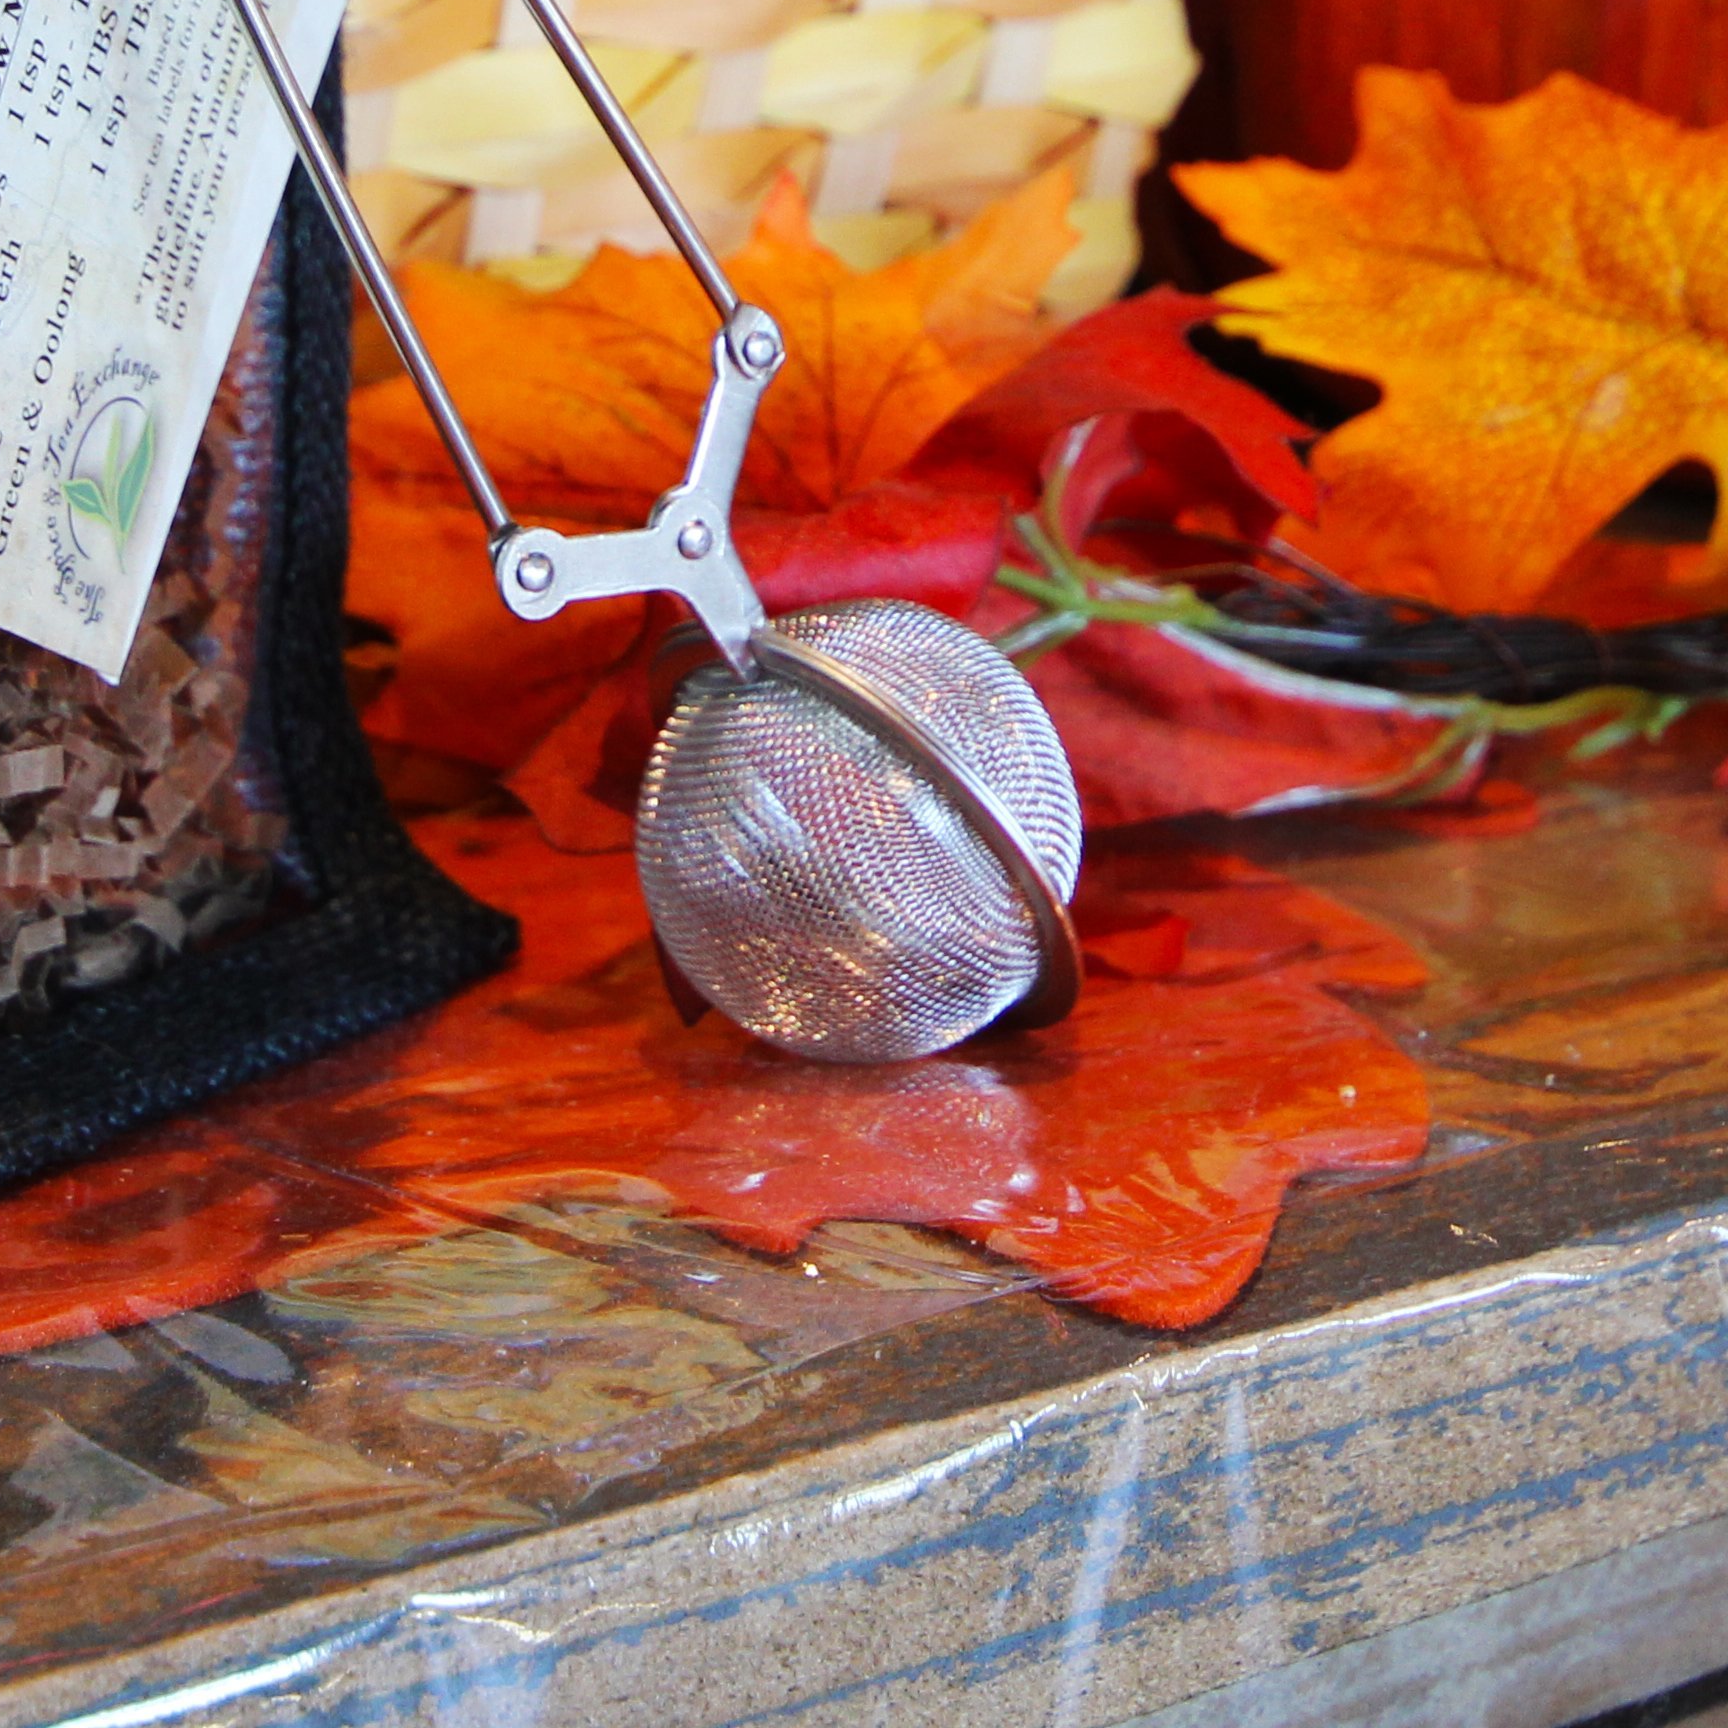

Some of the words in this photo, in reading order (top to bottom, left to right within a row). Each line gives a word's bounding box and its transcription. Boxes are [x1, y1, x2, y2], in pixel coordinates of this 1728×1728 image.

[8, 108, 26, 127] 1
[19, 38, 48, 94] tsp
[83, 4, 119, 83] TBS
[147, 14, 175, 86] Based
[34, 132, 52, 151] 1
[44, 63, 75, 118] tsp
[76, 99, 94, 117] 1
[133, 174, 152, 215] See
[148, 133, 164, 166] tea
[158, 59, 185, 125] labels
[179, 15, 196, 50] for
[164, 91, 203, 216] amount
[200, 44, 215, 82] of
[22, 400, 43, 431] &
[34, 251, 86, 384] Oolong
[89, 160, 108, 180] 1
[100, 93, 129, 149] tsp
[156, 169, 204, 326] guideline.
[172, 301, 187, 331] to
[184, 231, 206, 291] suit
[203, 145, 228, 223] your
